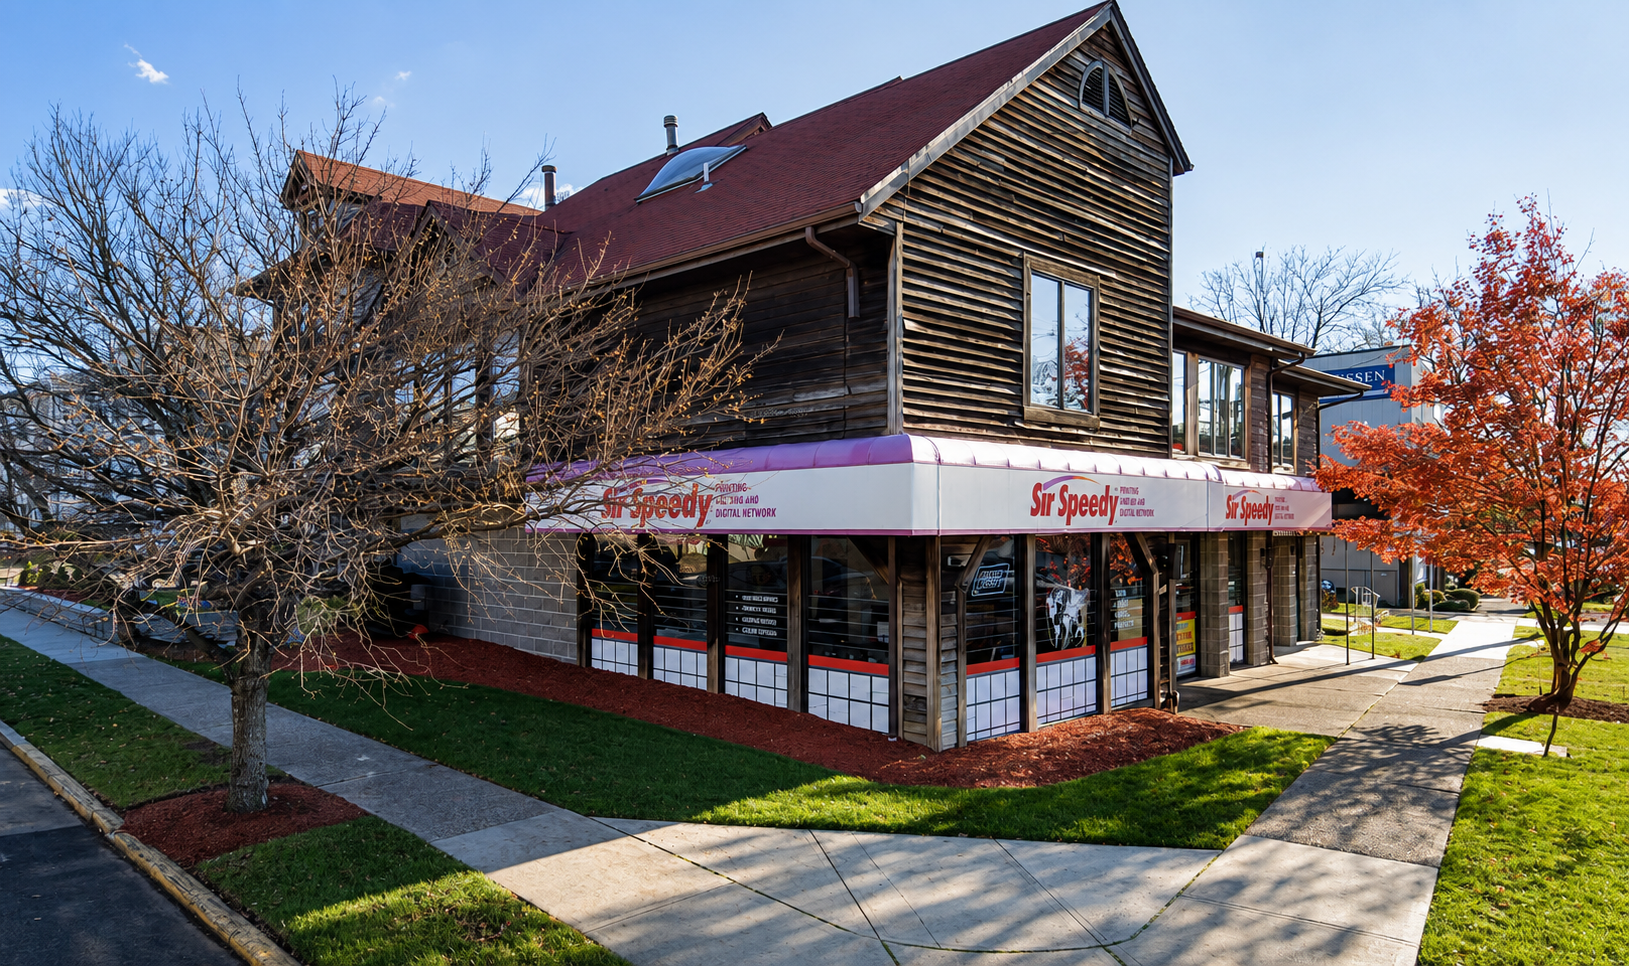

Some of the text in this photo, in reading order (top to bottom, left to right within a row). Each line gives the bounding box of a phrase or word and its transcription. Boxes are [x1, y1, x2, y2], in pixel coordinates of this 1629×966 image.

[601, 483, 713, 527] Sir Speedy
[715, 507, 777, 518] DIGITAL NETWORK
[1030, 482, 1120, 526] Sir Speedy
[1225, 494, 1274, 526] Sir Speedy
